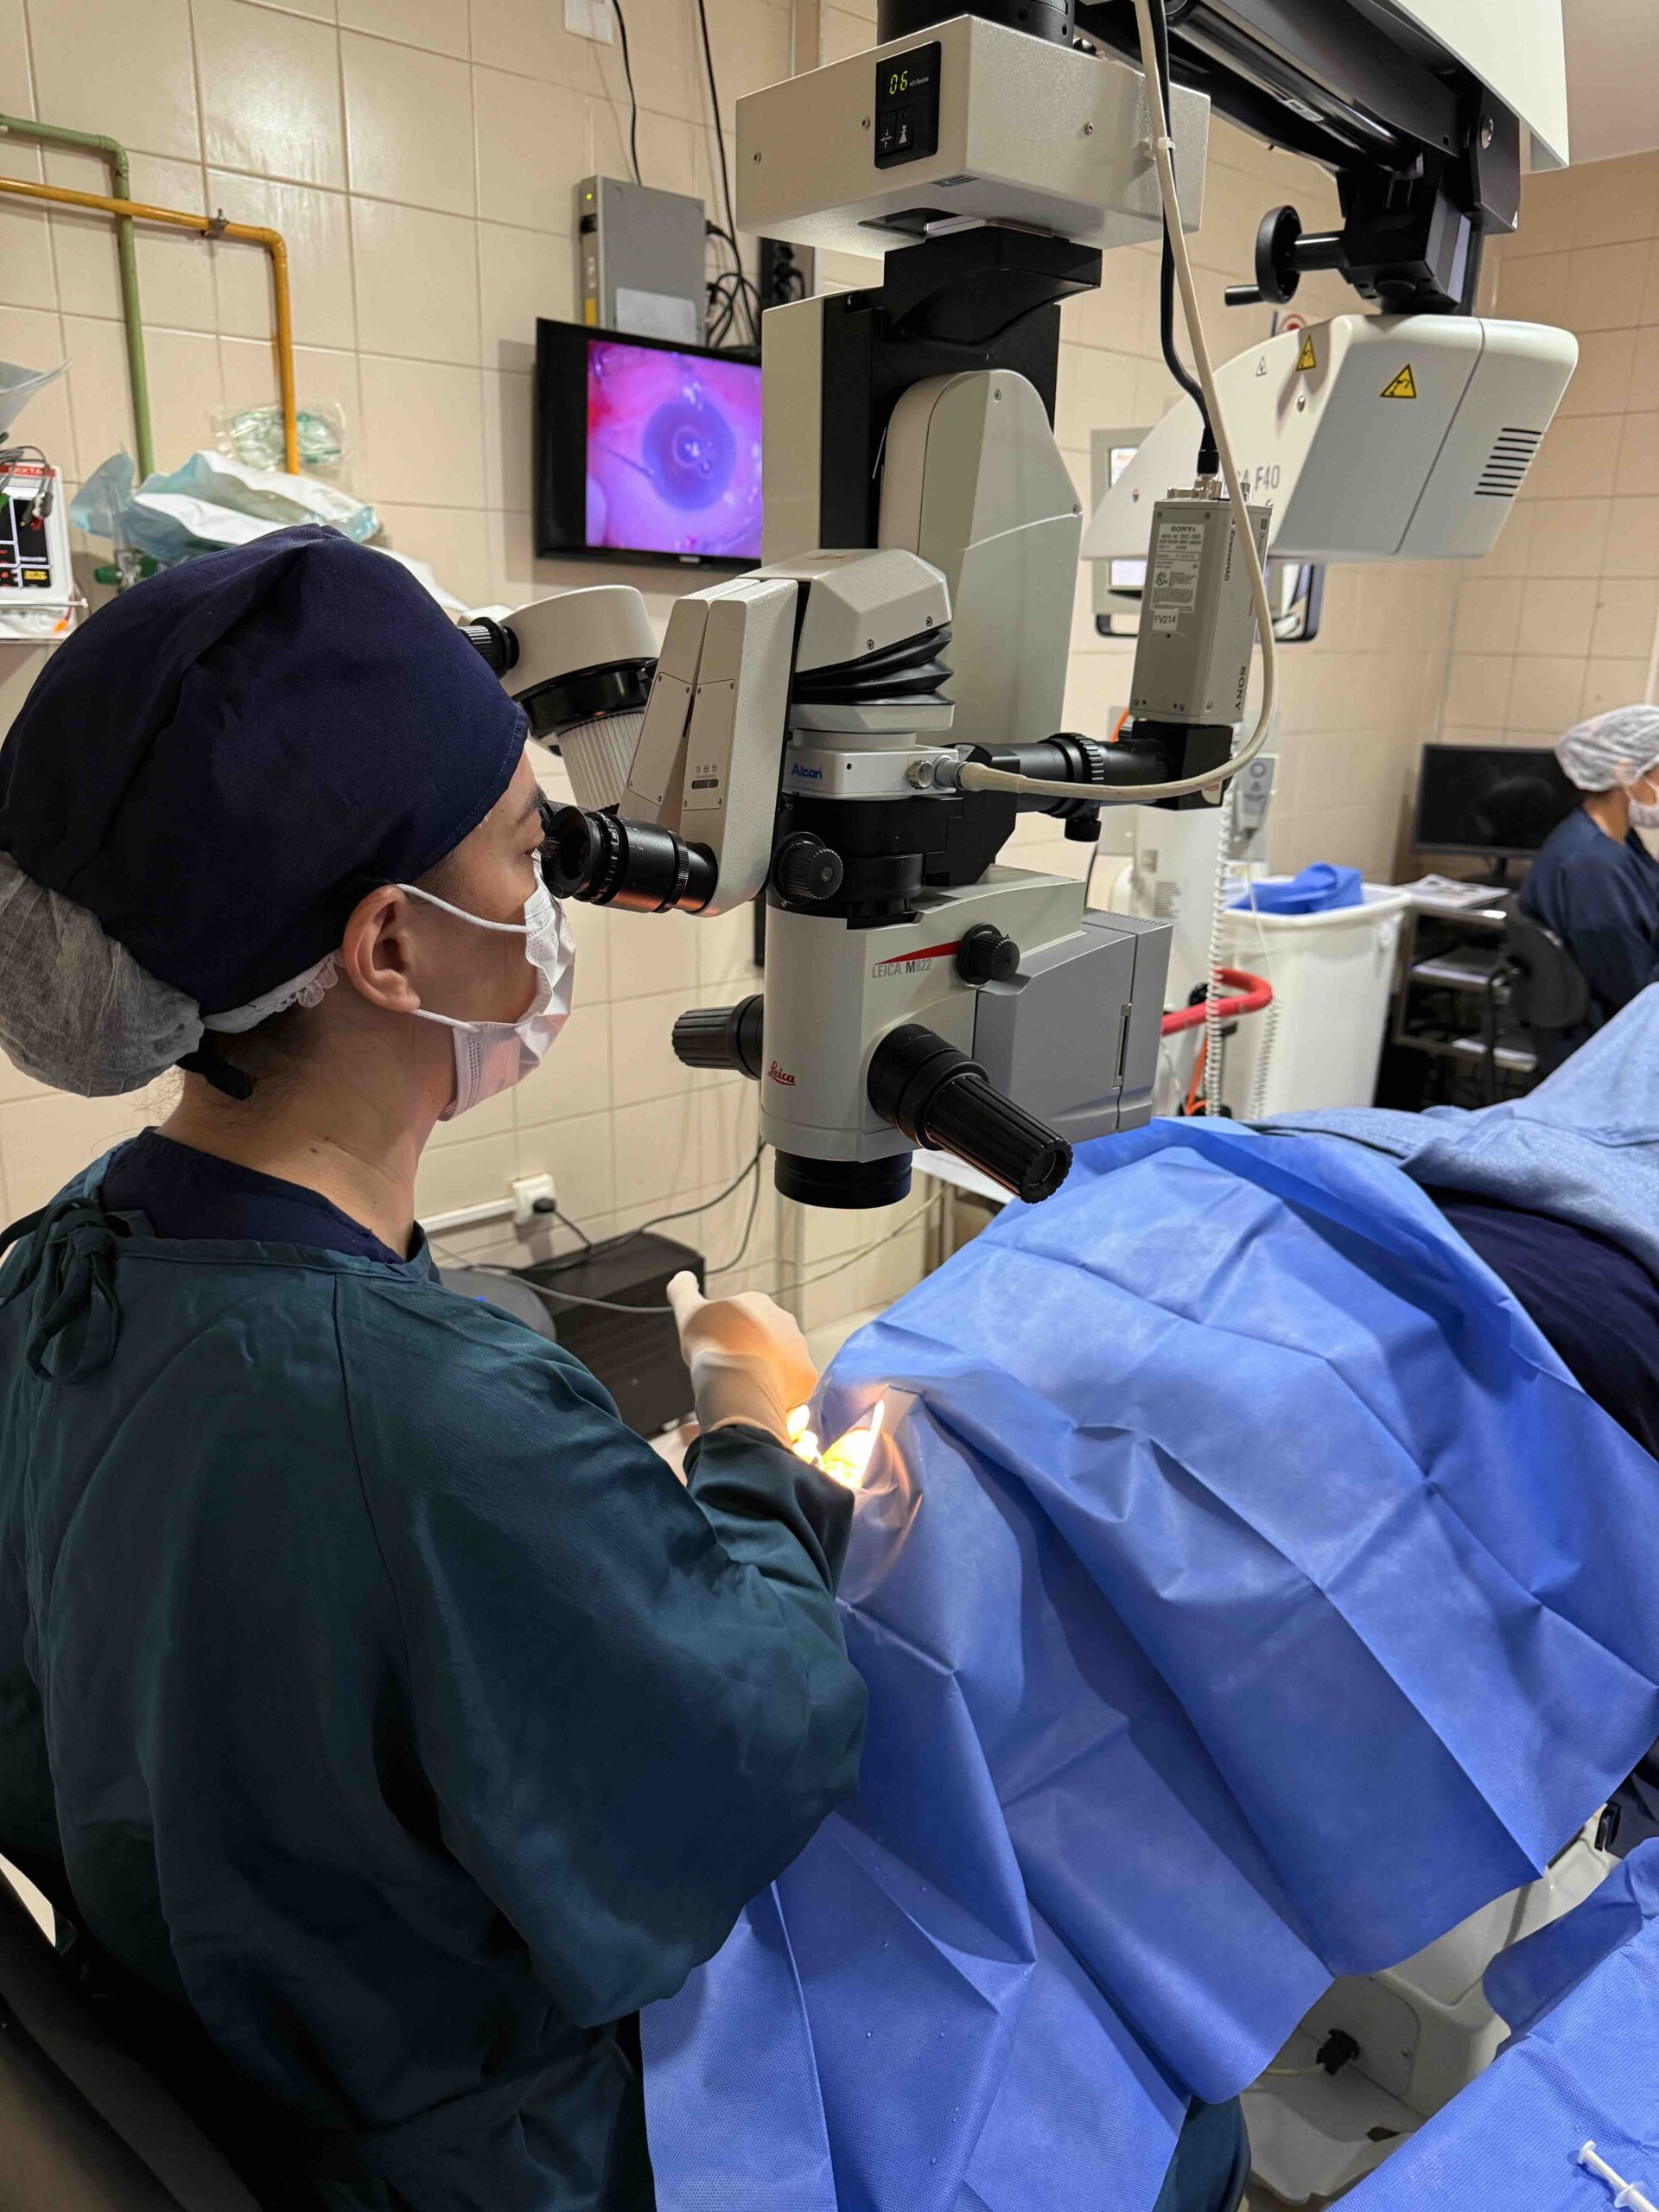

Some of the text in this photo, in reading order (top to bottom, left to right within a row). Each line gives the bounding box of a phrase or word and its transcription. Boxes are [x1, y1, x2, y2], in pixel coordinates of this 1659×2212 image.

[889, 70, 908, 95] 06
[1255, 465, 1281, 492] F40
[1154, 614, 1176, 624] FV214
[1236, 665, 1246, 711] SONY
[791, 763, 823, 779] Alcon
[872, 958, 932, 978] LEICA M822
[768, 1060, 796, 1085] Leica
